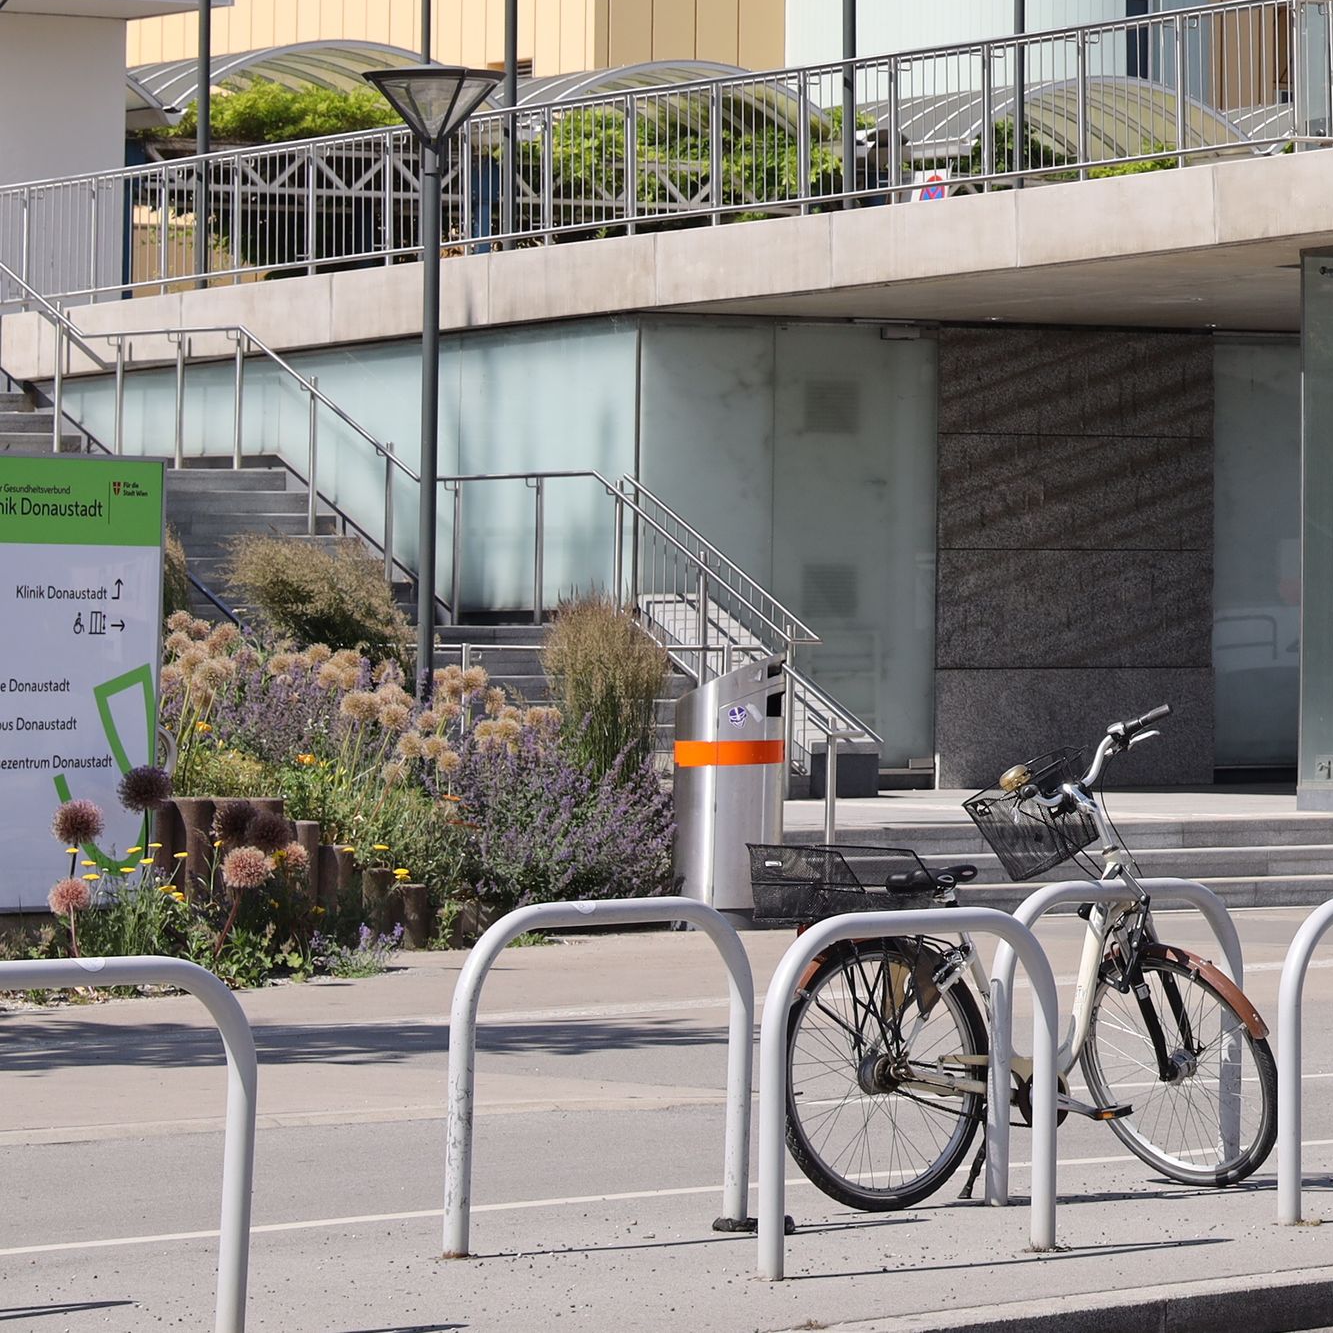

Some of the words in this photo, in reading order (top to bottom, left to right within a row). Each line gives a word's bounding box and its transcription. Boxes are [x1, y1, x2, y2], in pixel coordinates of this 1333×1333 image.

[4, 483, 71, 495] Gesundheitsverbund
[21, 497, 103, 517] Donaustadt
[16, 585, 45, 599] Klinik
[47, 585, 108, 600] Donaustadt
[9, 677, 70, 692] Donaustadt
[16, 716, 77, 731] Donaustadt
[0, 757, 50, 770] ezentrum
[53, 754, 113, 769] Donaustadt
